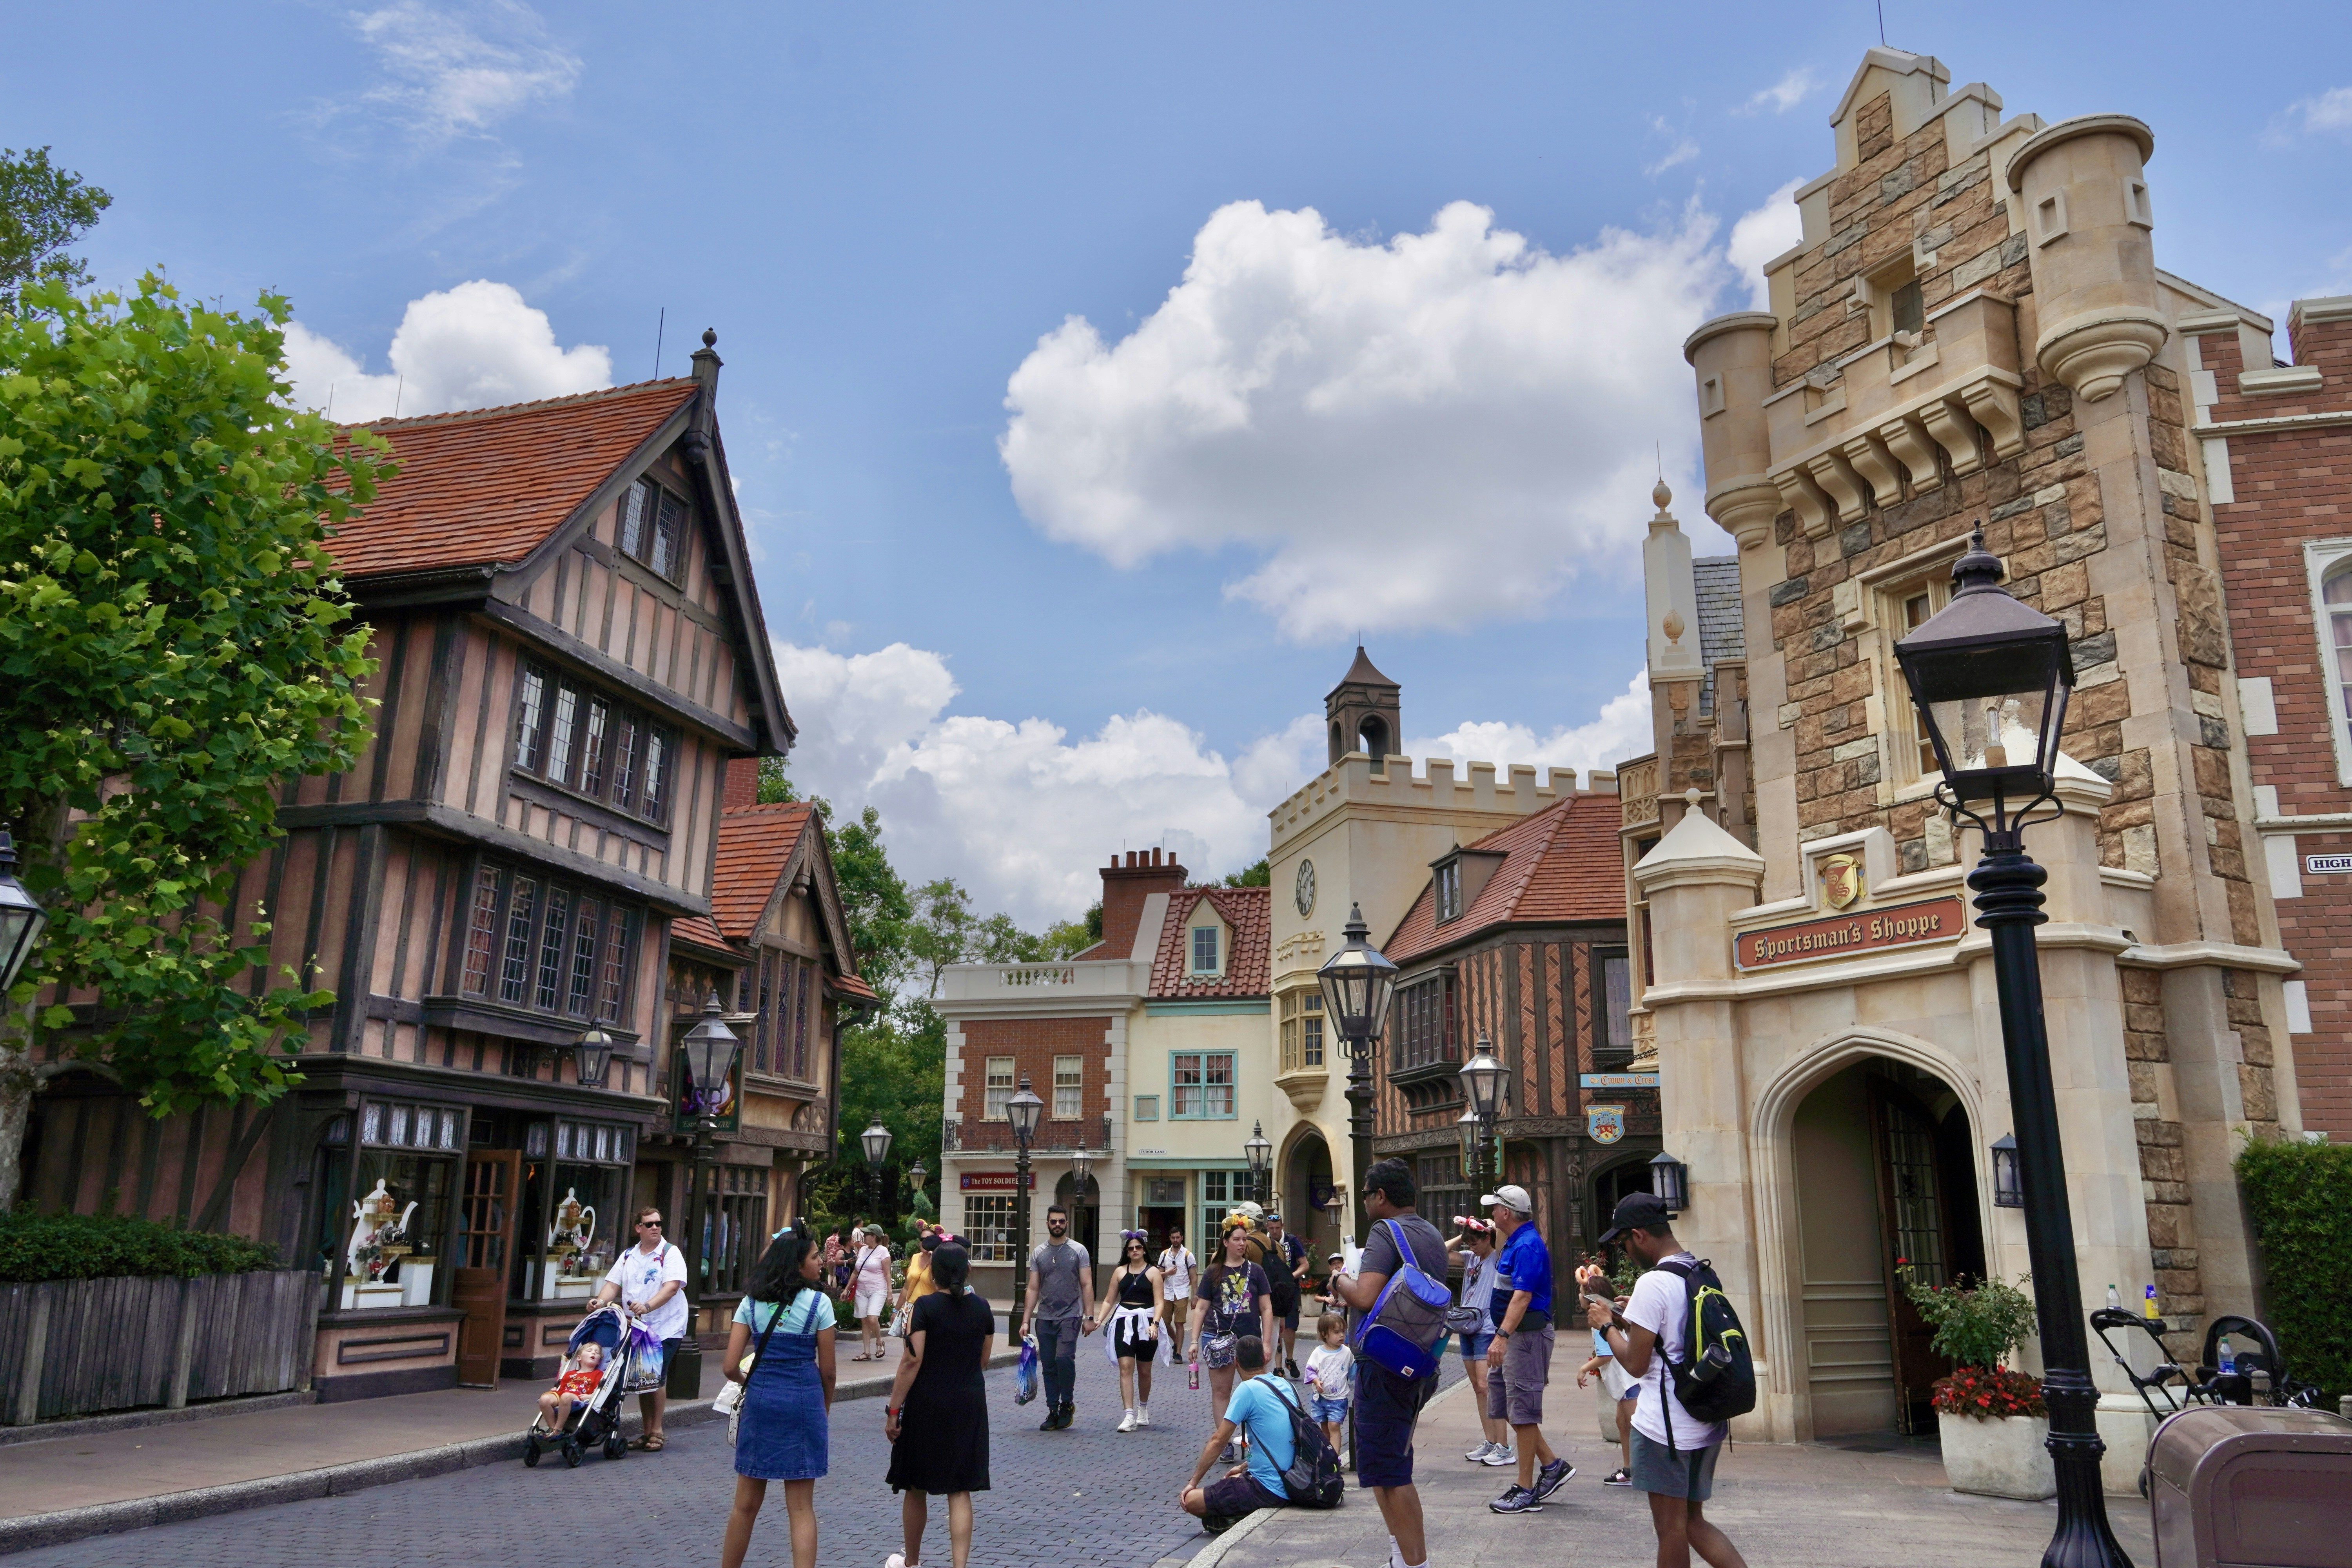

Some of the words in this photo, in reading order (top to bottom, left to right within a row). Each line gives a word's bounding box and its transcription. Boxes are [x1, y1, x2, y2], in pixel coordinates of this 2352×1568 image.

[2313, 859, 2351, 868] HIGH
[1754, 921, 1863, 962] Sportsman's
[1871, 913, 1942, 941] Shoppe
[1601, 1075, 1625, 1085] Crown
[1634, 1074, 1656, 1085] Crest
